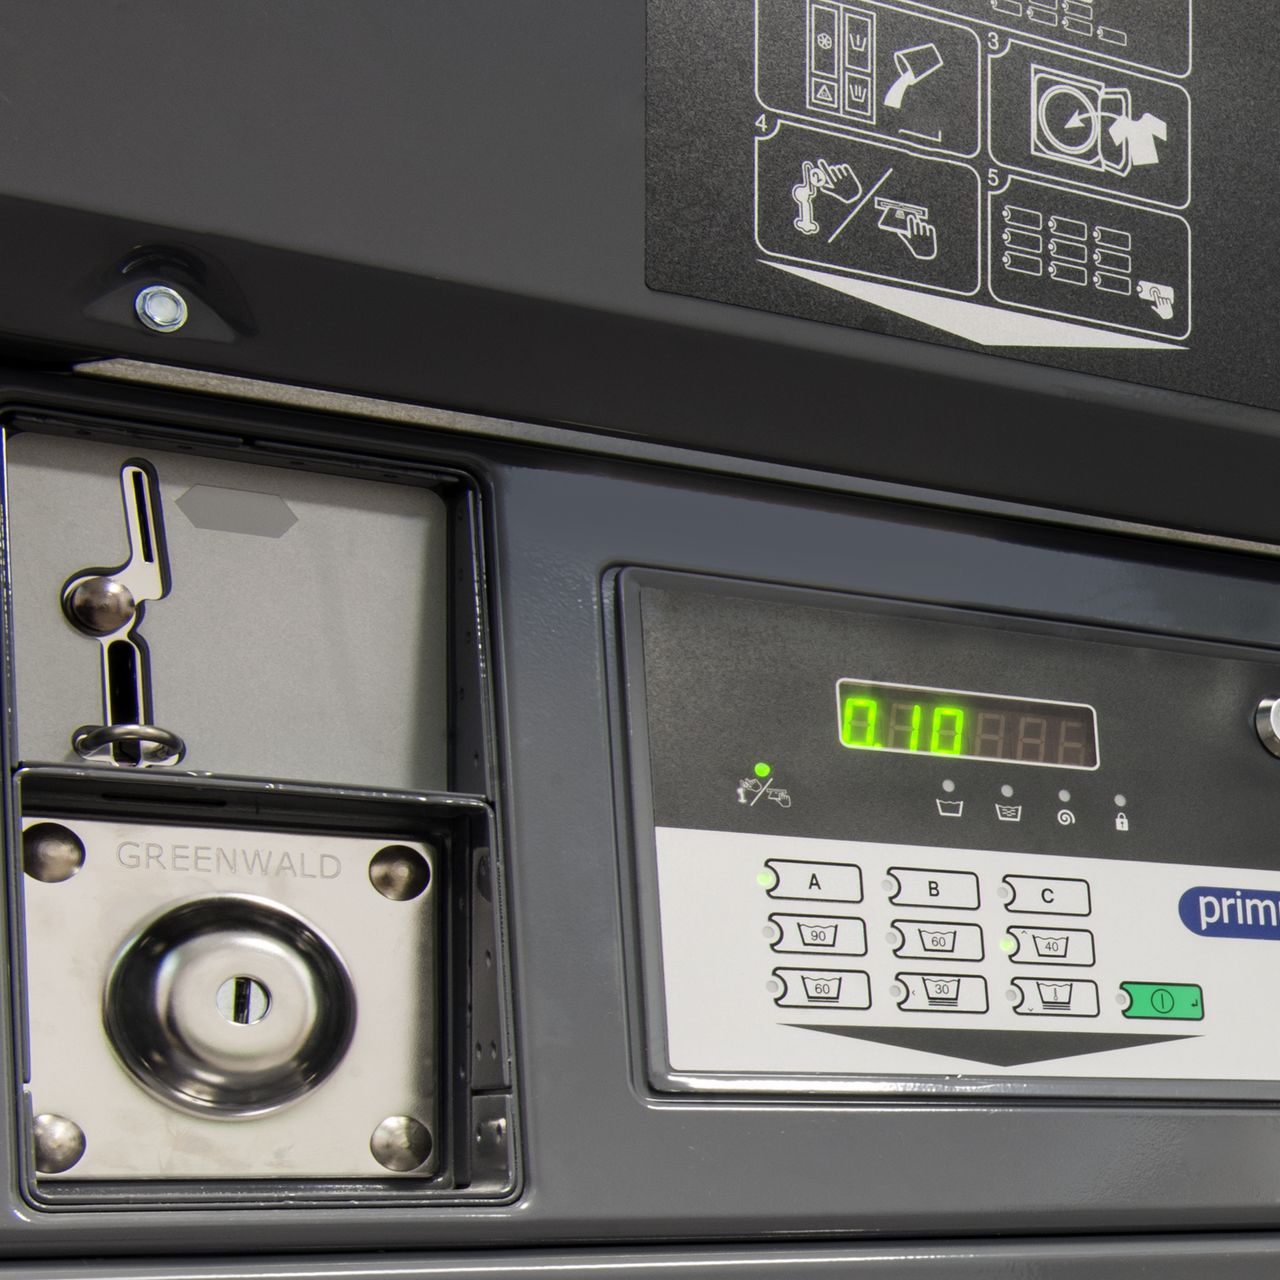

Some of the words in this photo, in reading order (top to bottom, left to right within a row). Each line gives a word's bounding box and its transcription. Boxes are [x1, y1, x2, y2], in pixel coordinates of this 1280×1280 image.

[988, 32, 999, 50] 3
[755, 114, 768, 132] 4
[987, 169, 999, 187] 5
[115, 840, 342, 880] GREENWALD
[808, 873, 822, 891] A
[928, 881, 940, 898] B
[1041, 888, 1054, 904] C
[810, 929, 826, 943] 90
[931, 934, 947, 949] 60
[1044, 940, 1059, 953] 40
[814, 982, 830, 997] 60
[934, 982, 950, 996] 30
